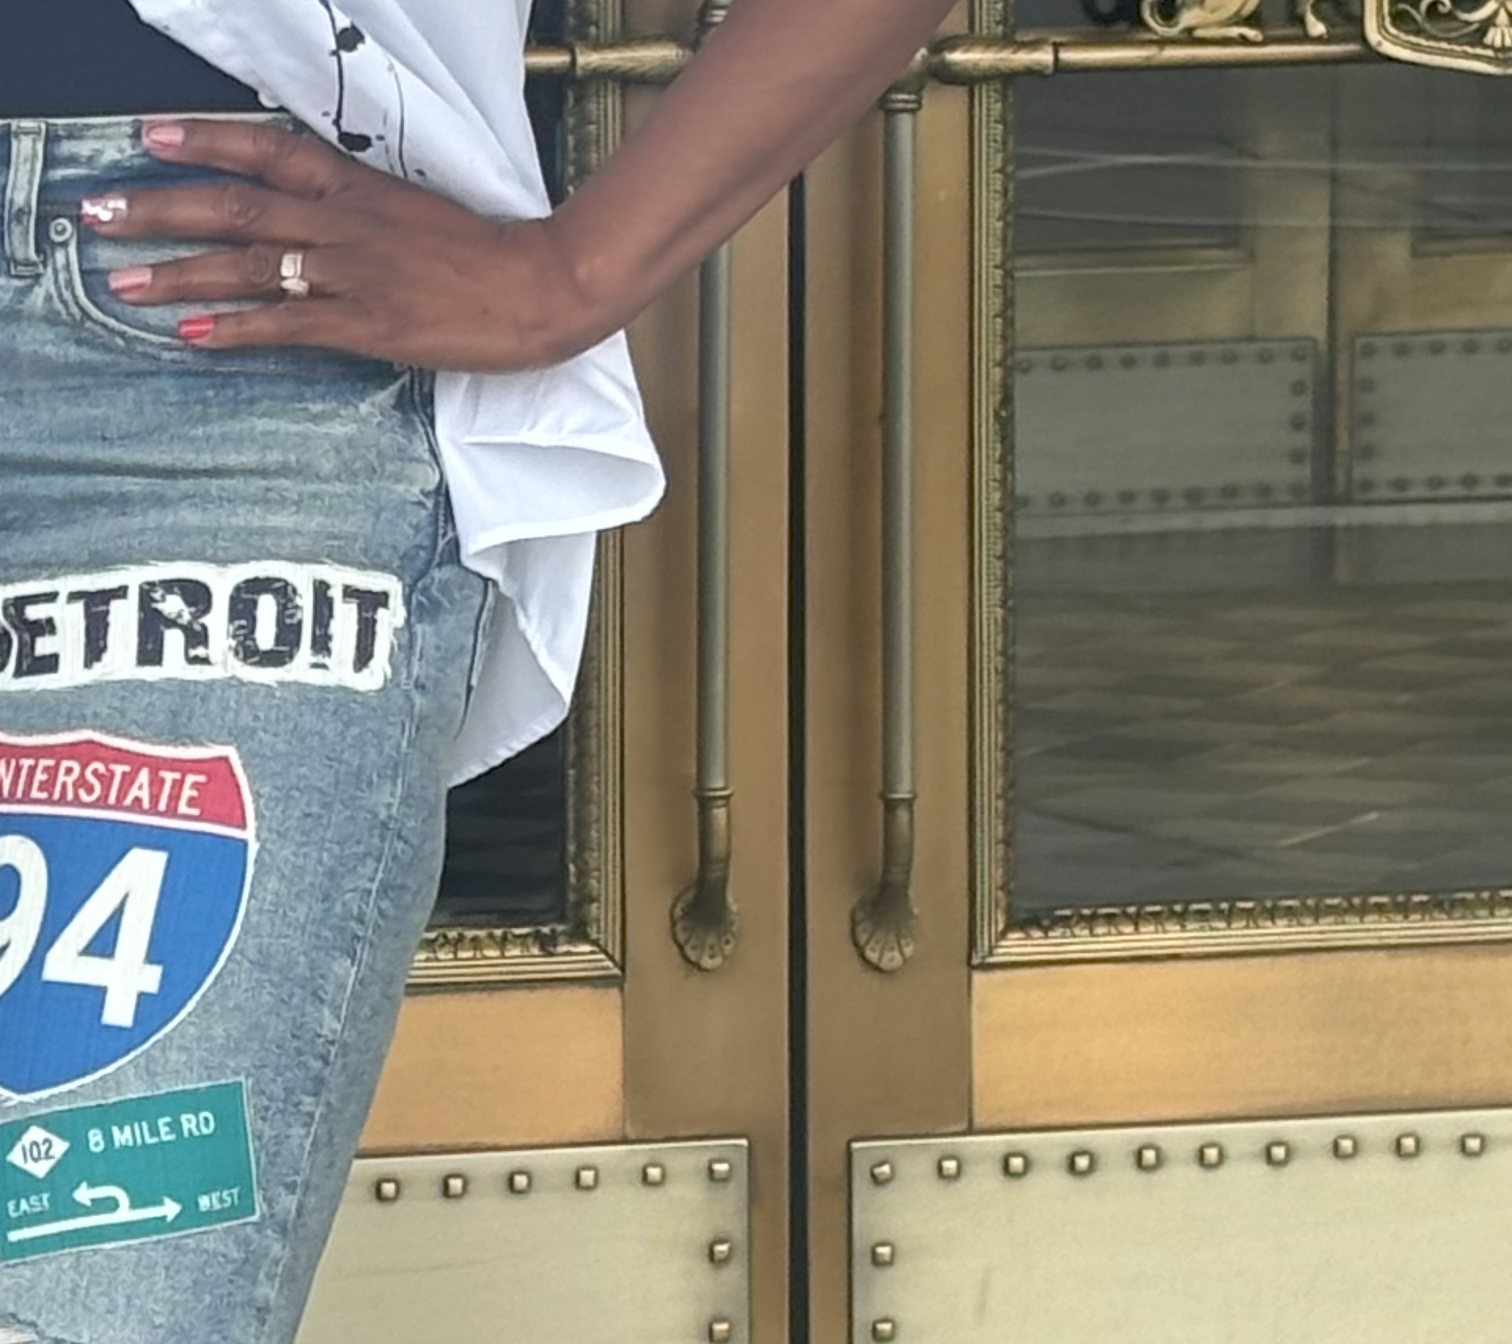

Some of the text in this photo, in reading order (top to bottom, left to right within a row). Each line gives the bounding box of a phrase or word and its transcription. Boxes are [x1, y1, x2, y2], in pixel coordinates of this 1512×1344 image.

[87, 1111, 216, 1154] 8 MILE RD
[21, 1137, 56, 1165] 102
[6, 1192, 52, 1219] EAST
[196, 1186, 241, 1213] WEST
